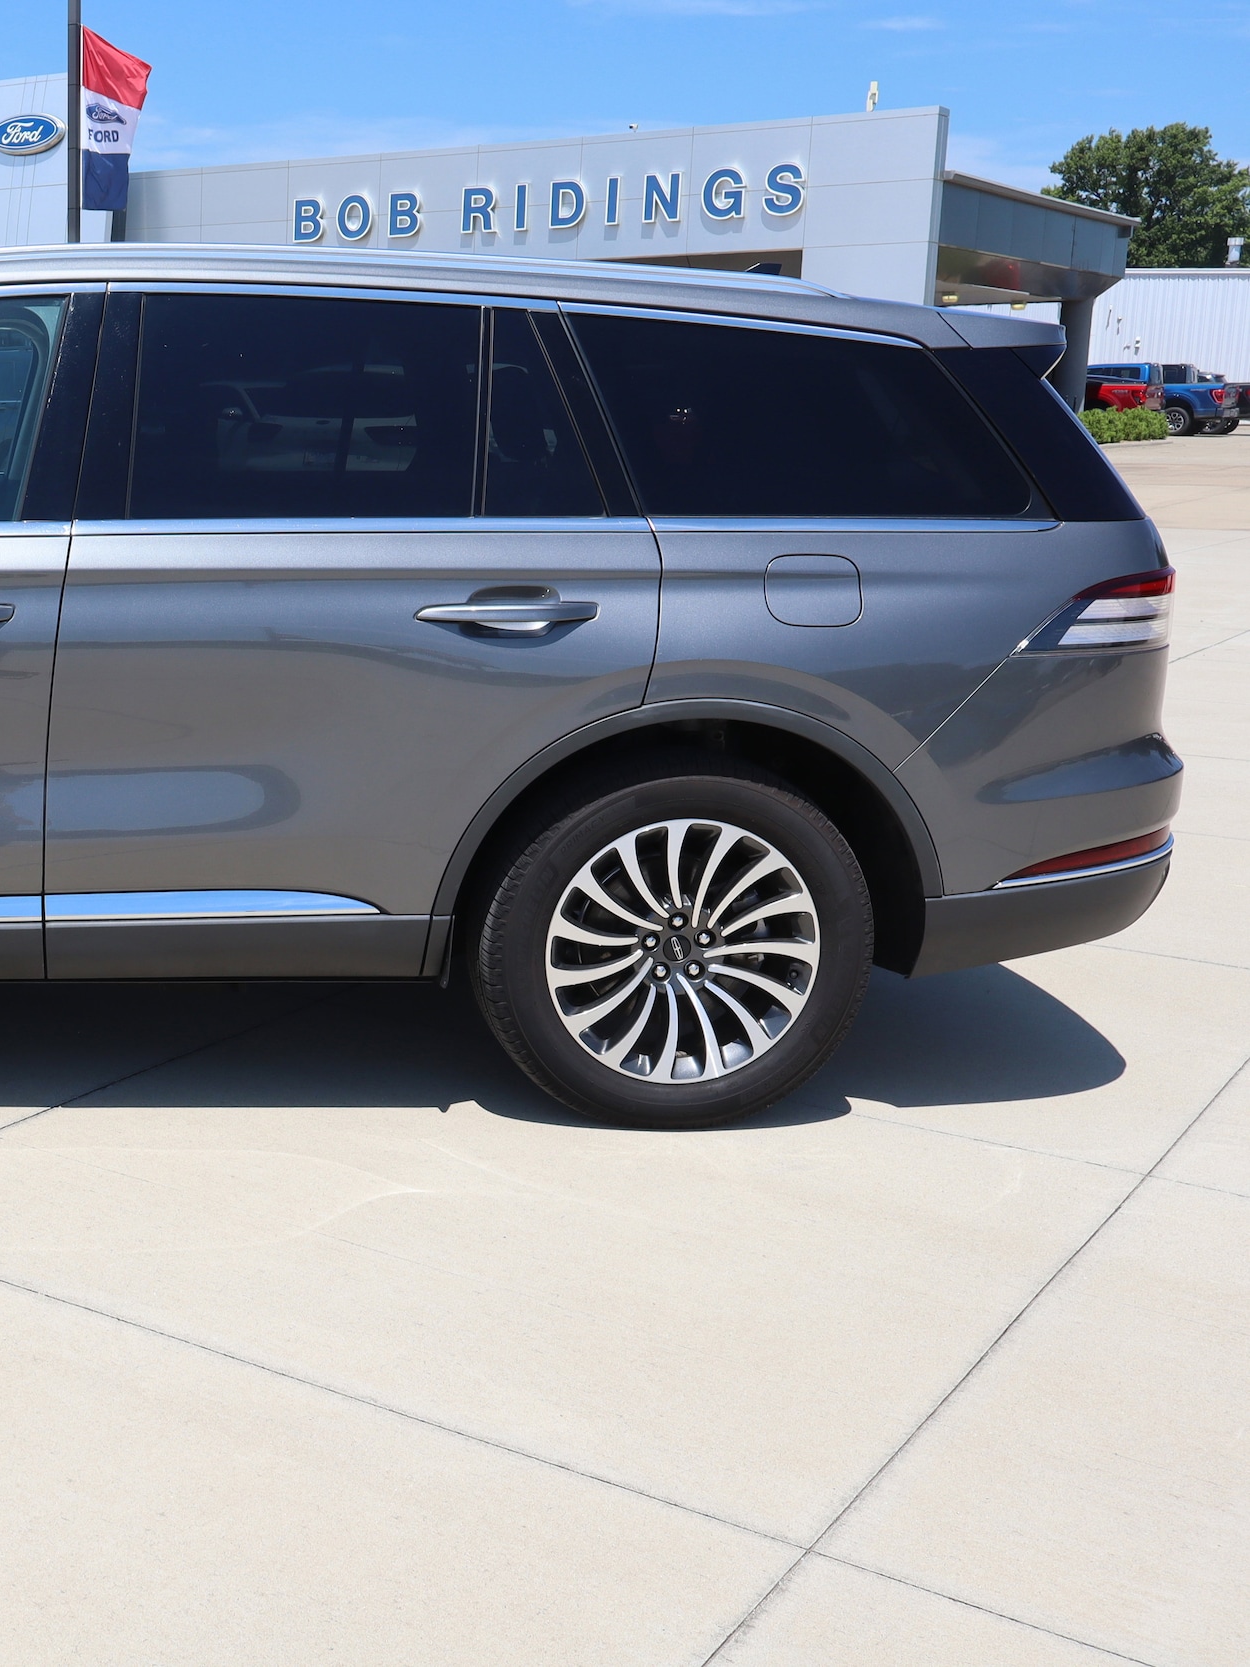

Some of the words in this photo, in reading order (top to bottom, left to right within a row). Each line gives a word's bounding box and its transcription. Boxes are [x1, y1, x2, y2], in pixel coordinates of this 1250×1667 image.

[1, 121, 44, 145] Ford
[88, 128, 119, 143] FORD
[292, 190, 421, 243] BOB
[460, 162, 806, 234] RIDINGS
[560, 815, 607, 854] PRIMACY
